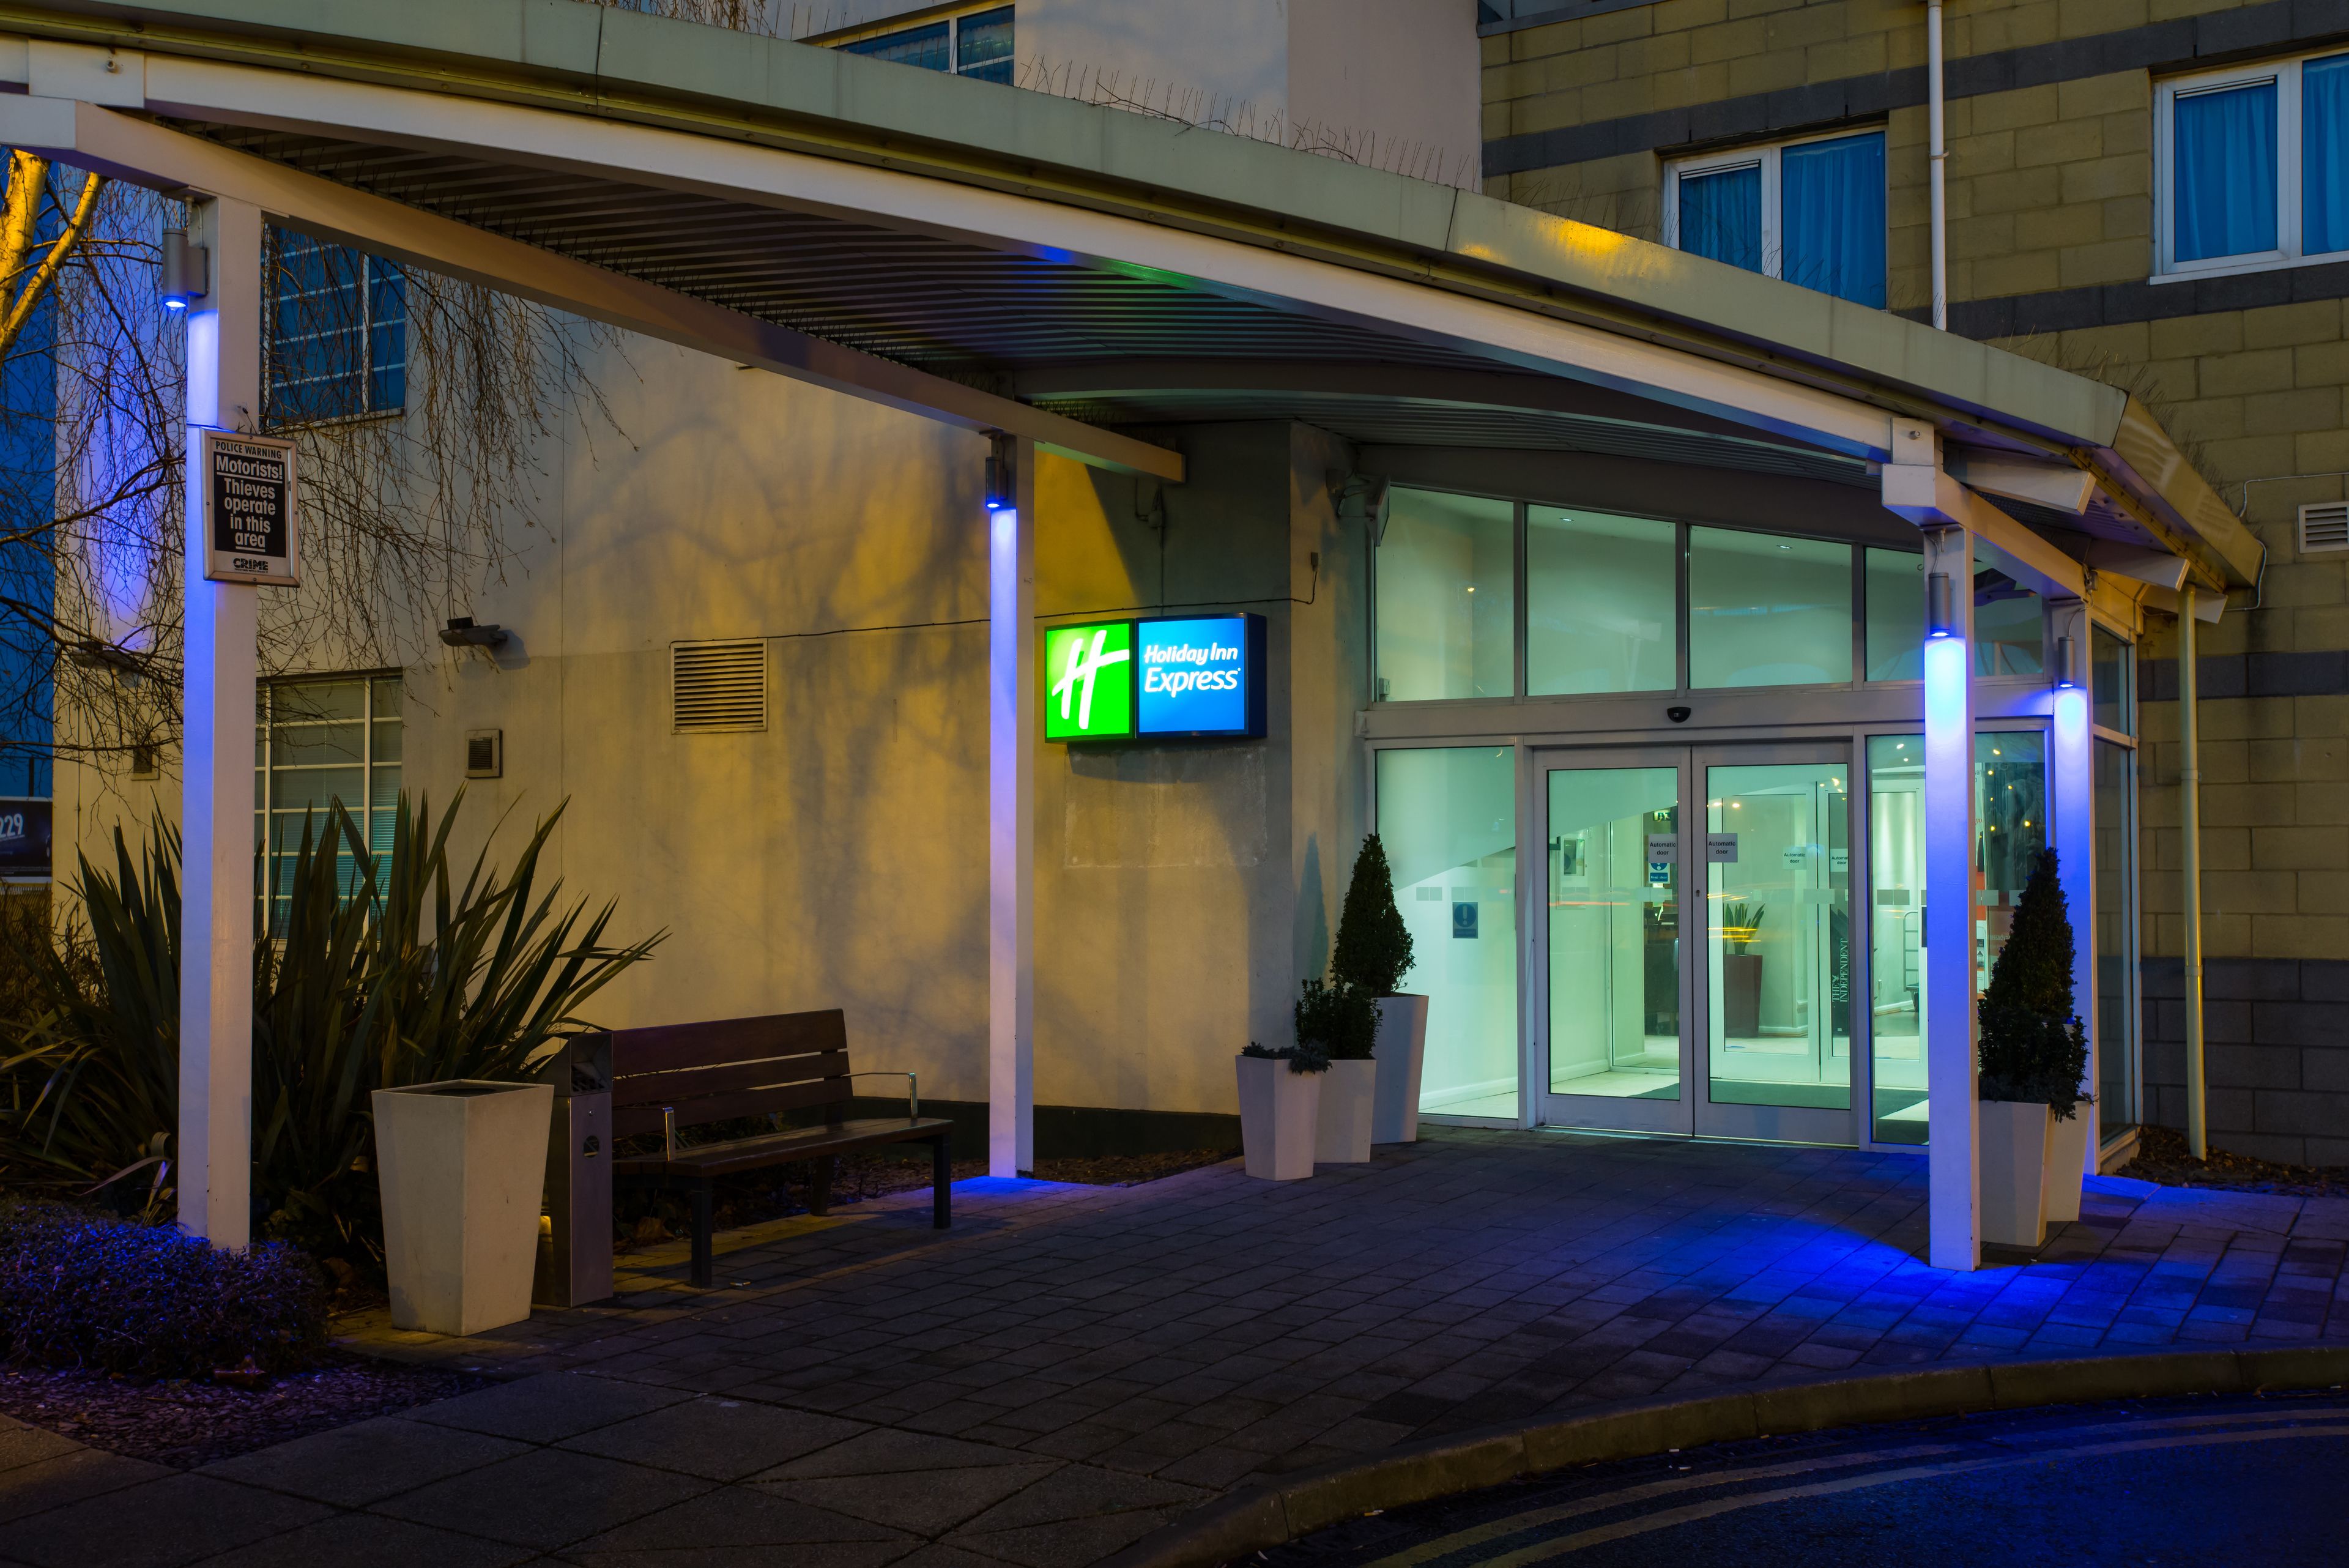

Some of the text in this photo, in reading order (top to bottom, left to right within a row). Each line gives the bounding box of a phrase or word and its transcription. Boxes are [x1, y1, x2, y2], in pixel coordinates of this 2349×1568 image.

[216, 440, 282, 459] POLICE WARNING
[217, 455, 283, 480] Motorists!
[224, 478, 276, 499] Thieves
[224, 497, 276, 516] operate
[230, 513, 271, 533] in this
[235, 532, 265, 548] area
[233, 558, 269, 570] CRIME
[1144, 642, 1238, 665] Holiday Inn
[1145, 667, 1239, 697] Express
